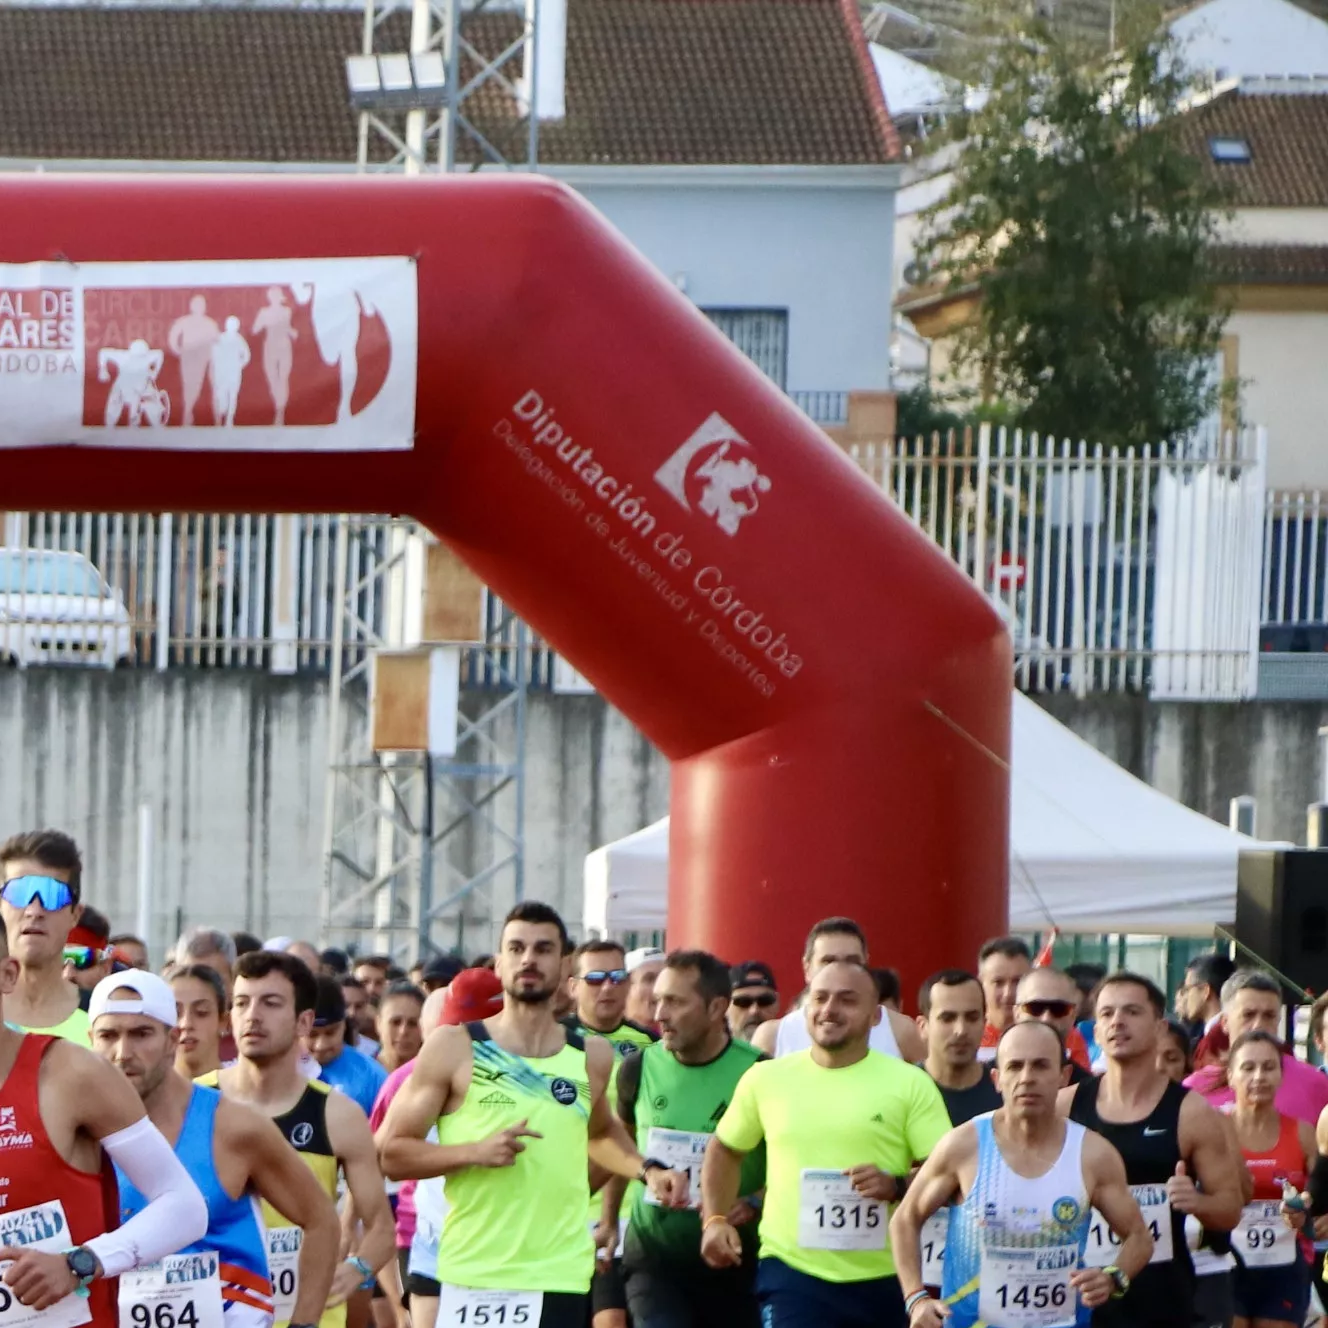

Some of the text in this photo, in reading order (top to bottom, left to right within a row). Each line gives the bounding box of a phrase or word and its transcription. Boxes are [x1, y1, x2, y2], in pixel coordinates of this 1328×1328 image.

[41, 290, 74, 318] DE
[512, 389, 804, 679] Diputación de Córdoba
[815, 1204, 880, 1229] 1315
[1246, 1227, 1276, 1249] 99
[996, 1282, 1067, 1309] 1456
[455, 1303, 530, 1326] 1515
